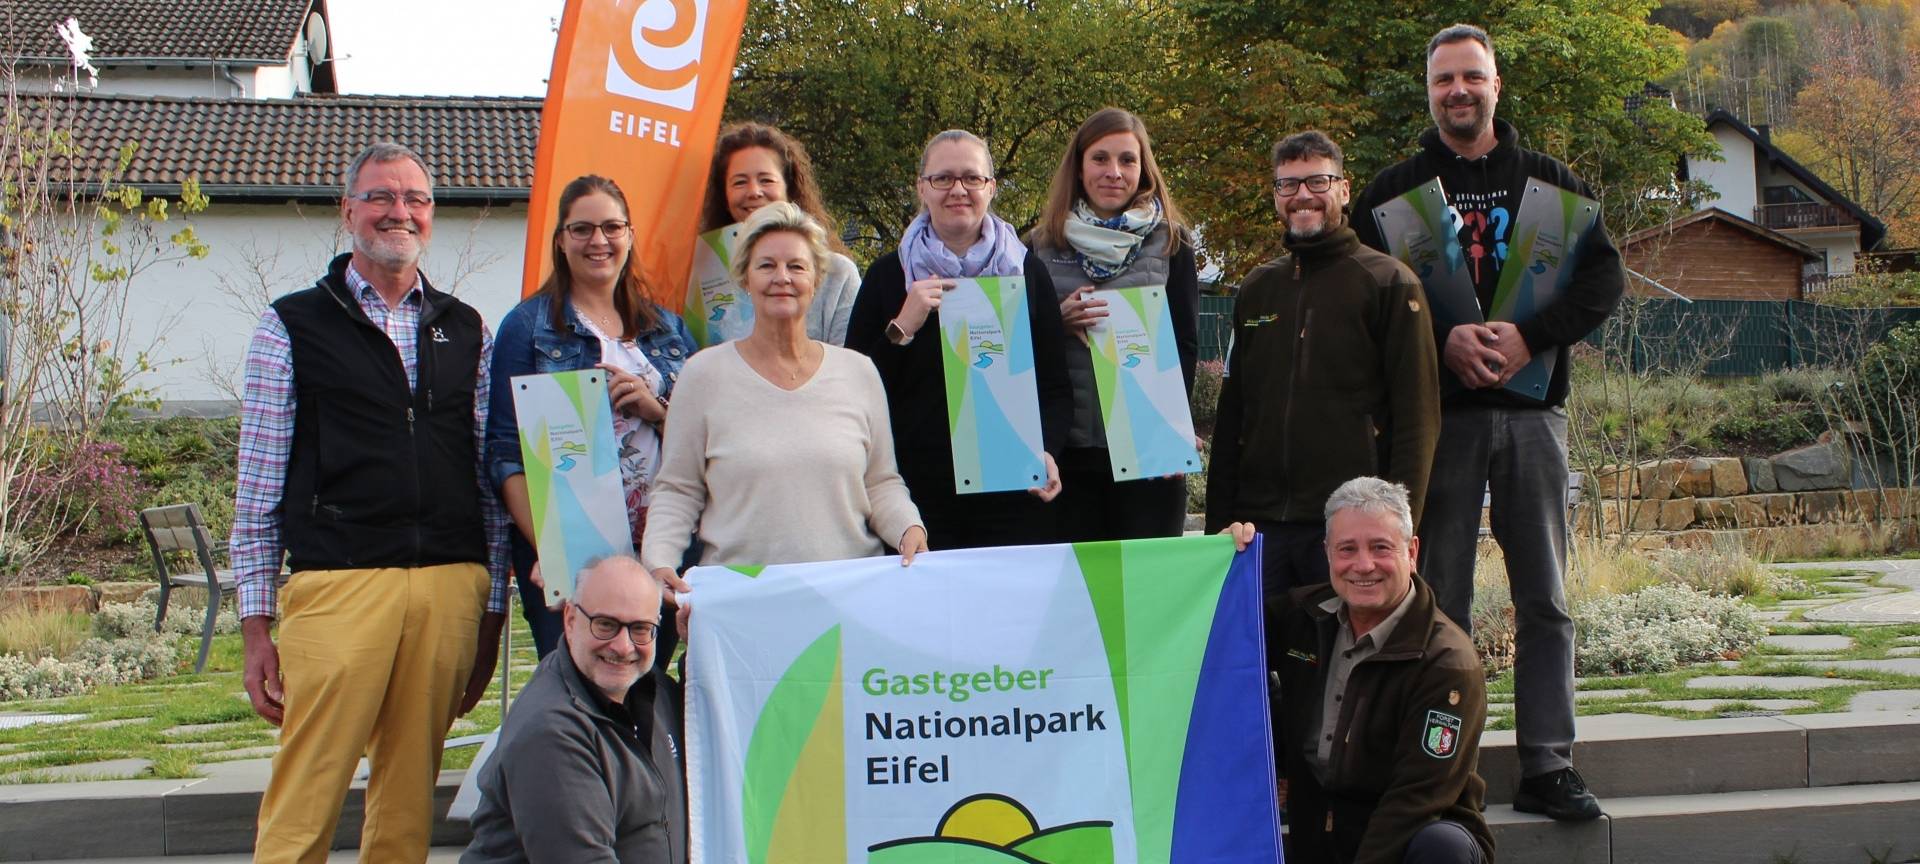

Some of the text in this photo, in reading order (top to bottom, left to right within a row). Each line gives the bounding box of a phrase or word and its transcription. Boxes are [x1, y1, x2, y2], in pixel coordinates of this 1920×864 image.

[609, 110, 681, 147] EIFEL
[862, 664, 1054, 702] Gastgeber
[865, 704, 1107, 742] Nationalpark
[867, 755, 950, 785] Eifel
